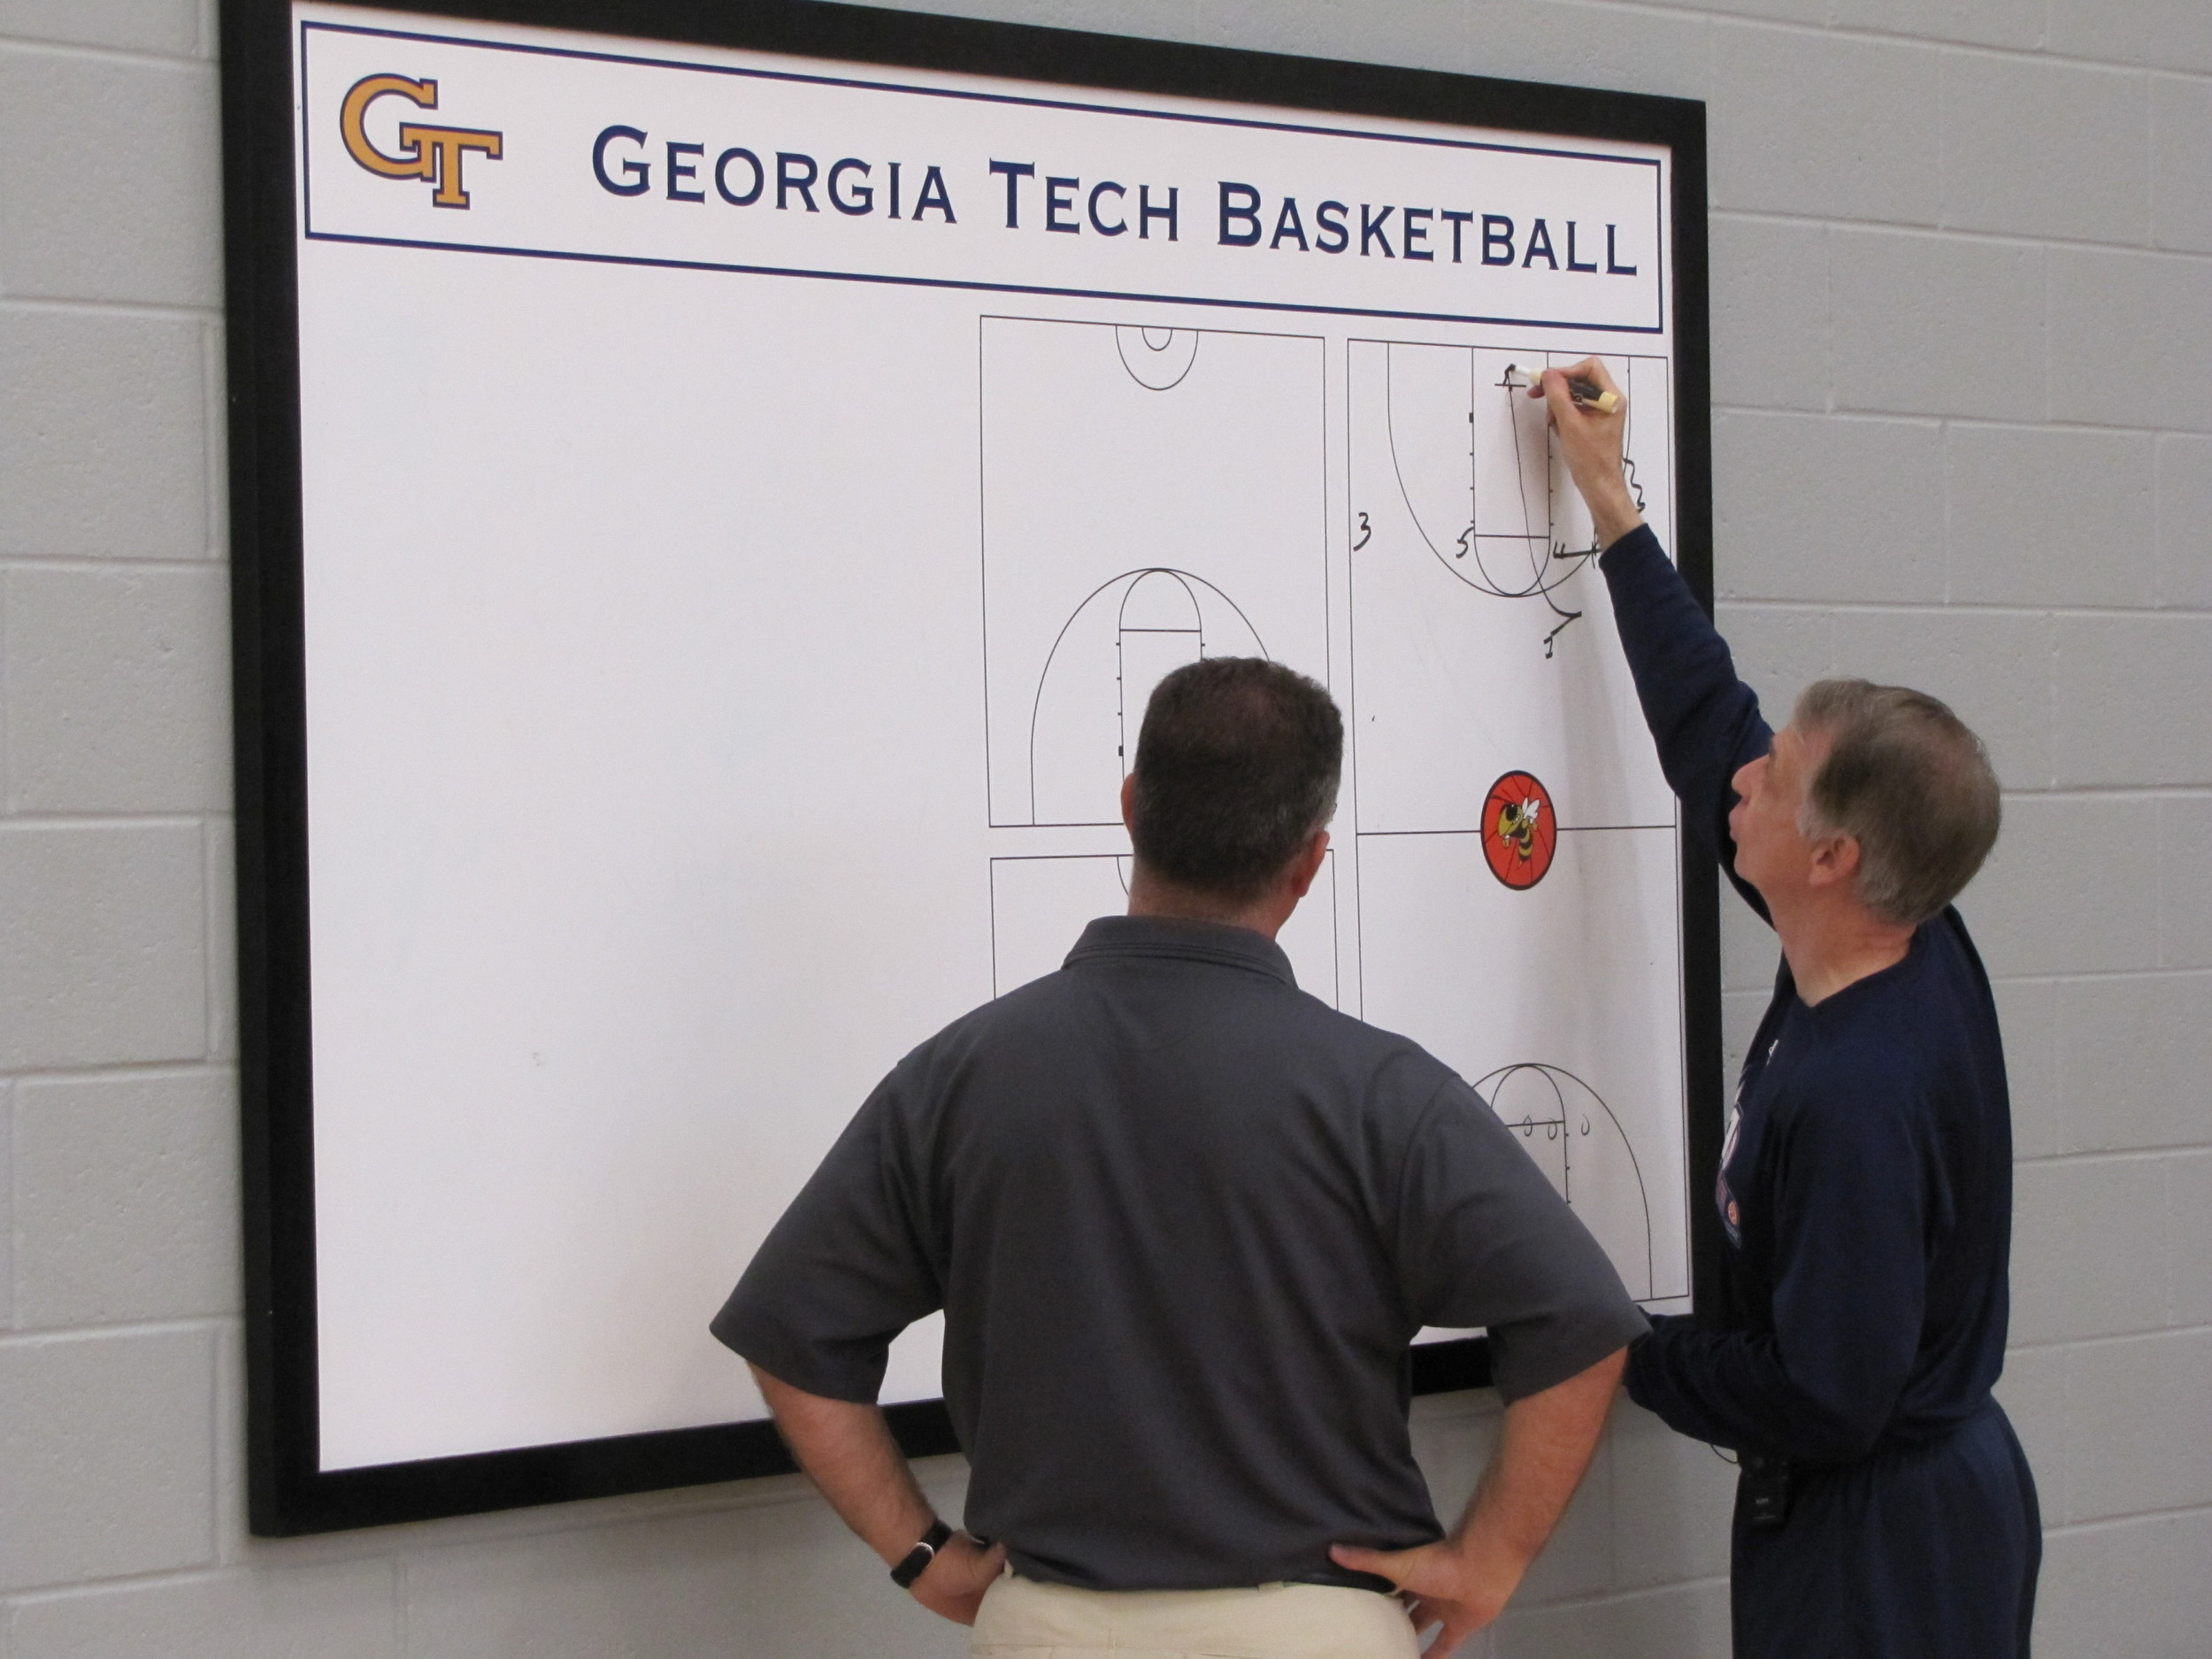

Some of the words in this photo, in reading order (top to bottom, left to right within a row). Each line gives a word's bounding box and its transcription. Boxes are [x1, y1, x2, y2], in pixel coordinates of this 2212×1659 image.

[339, 73, 503, 211] GT
[591, 124, 958, 225] GEORGIA
[987, 157, 1179, 242] TECH
[1217, 180, 1639, 277] BASKETBALL
[1353, 511, 1371, 551] 3
